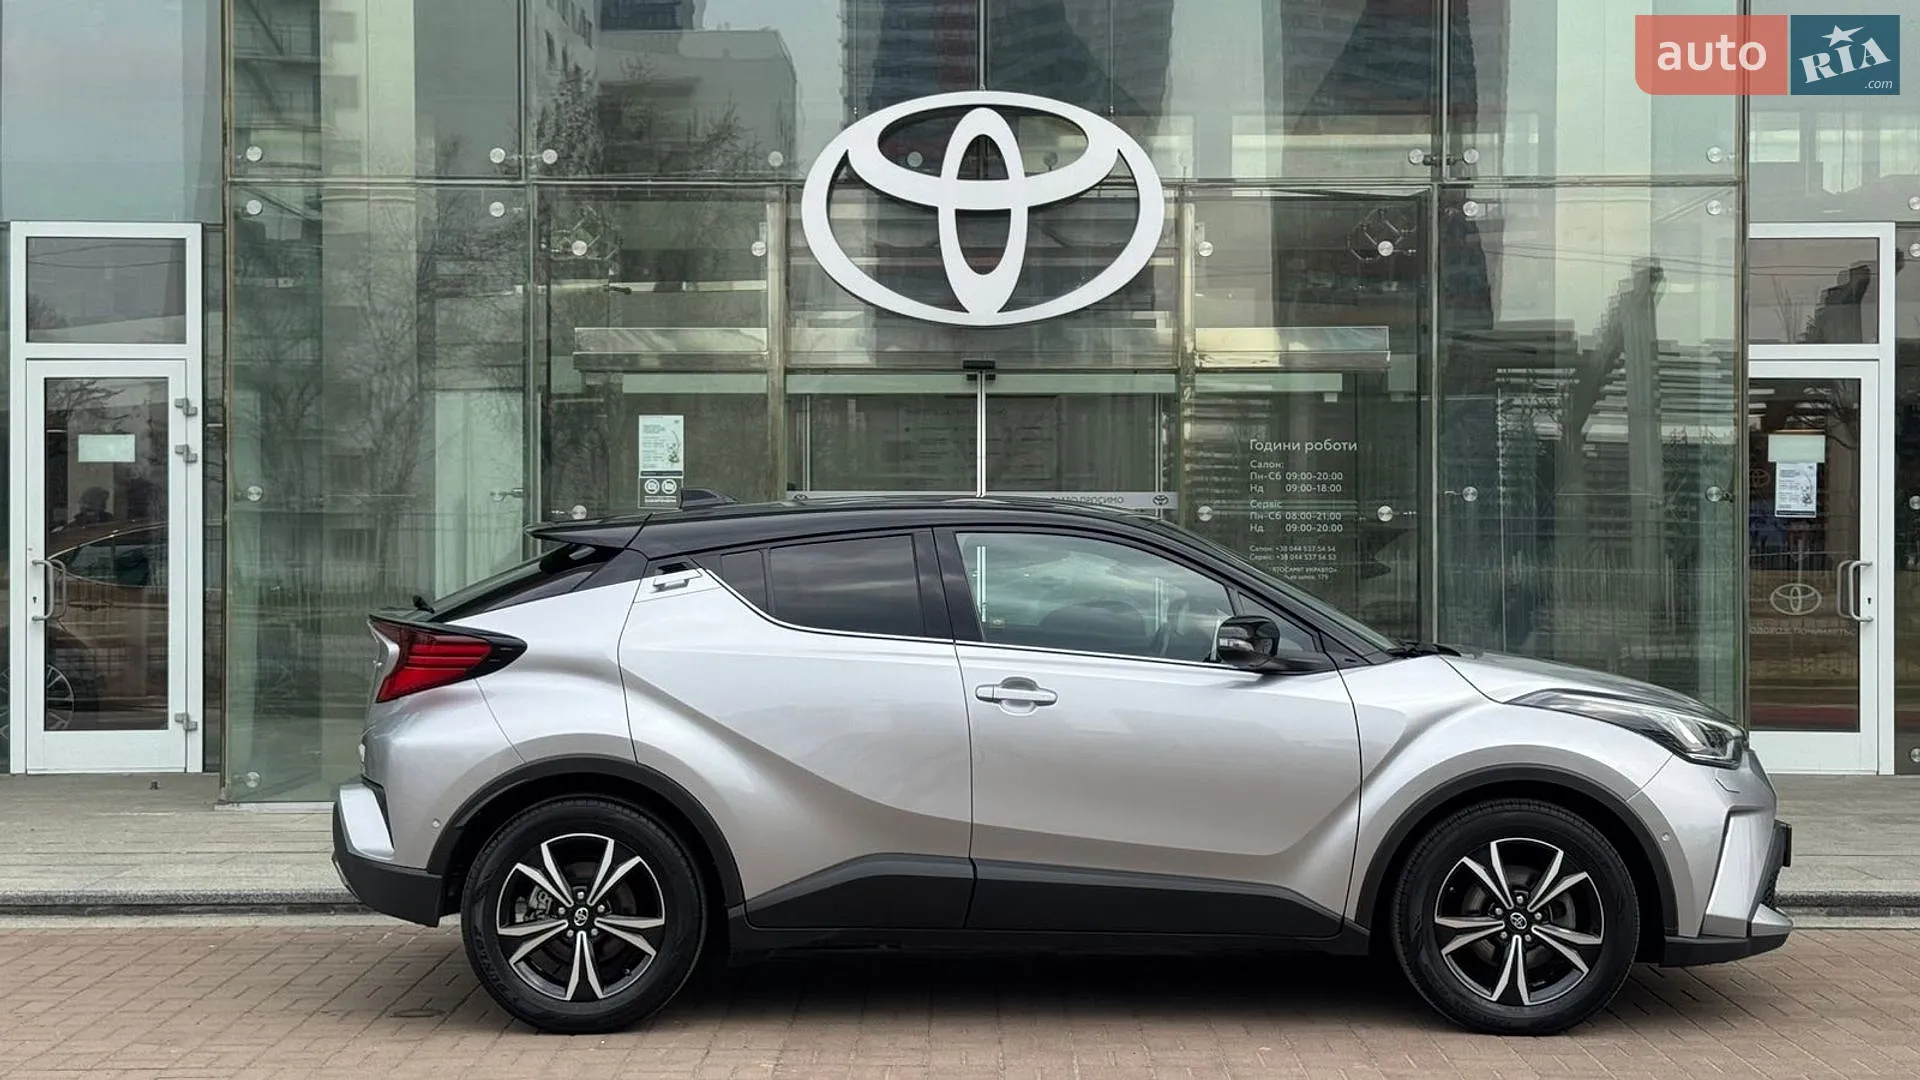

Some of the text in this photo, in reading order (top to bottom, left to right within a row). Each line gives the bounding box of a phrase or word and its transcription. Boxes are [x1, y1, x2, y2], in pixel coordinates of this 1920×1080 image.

[1249, 438, 1358, 454] Години роботи
[1249, 459, 1285, 469] Салон:
[1249, 471, 1343, 481] Пн-Сб 09:00-20:00
[1249, 483, 1342, 494] Нд 09:00-18:00
[1249, 511, 1342, 521] Пн-Сб 08:00-21:00
[1249, 523, 1343, 534] Нд 09:00-20:00
